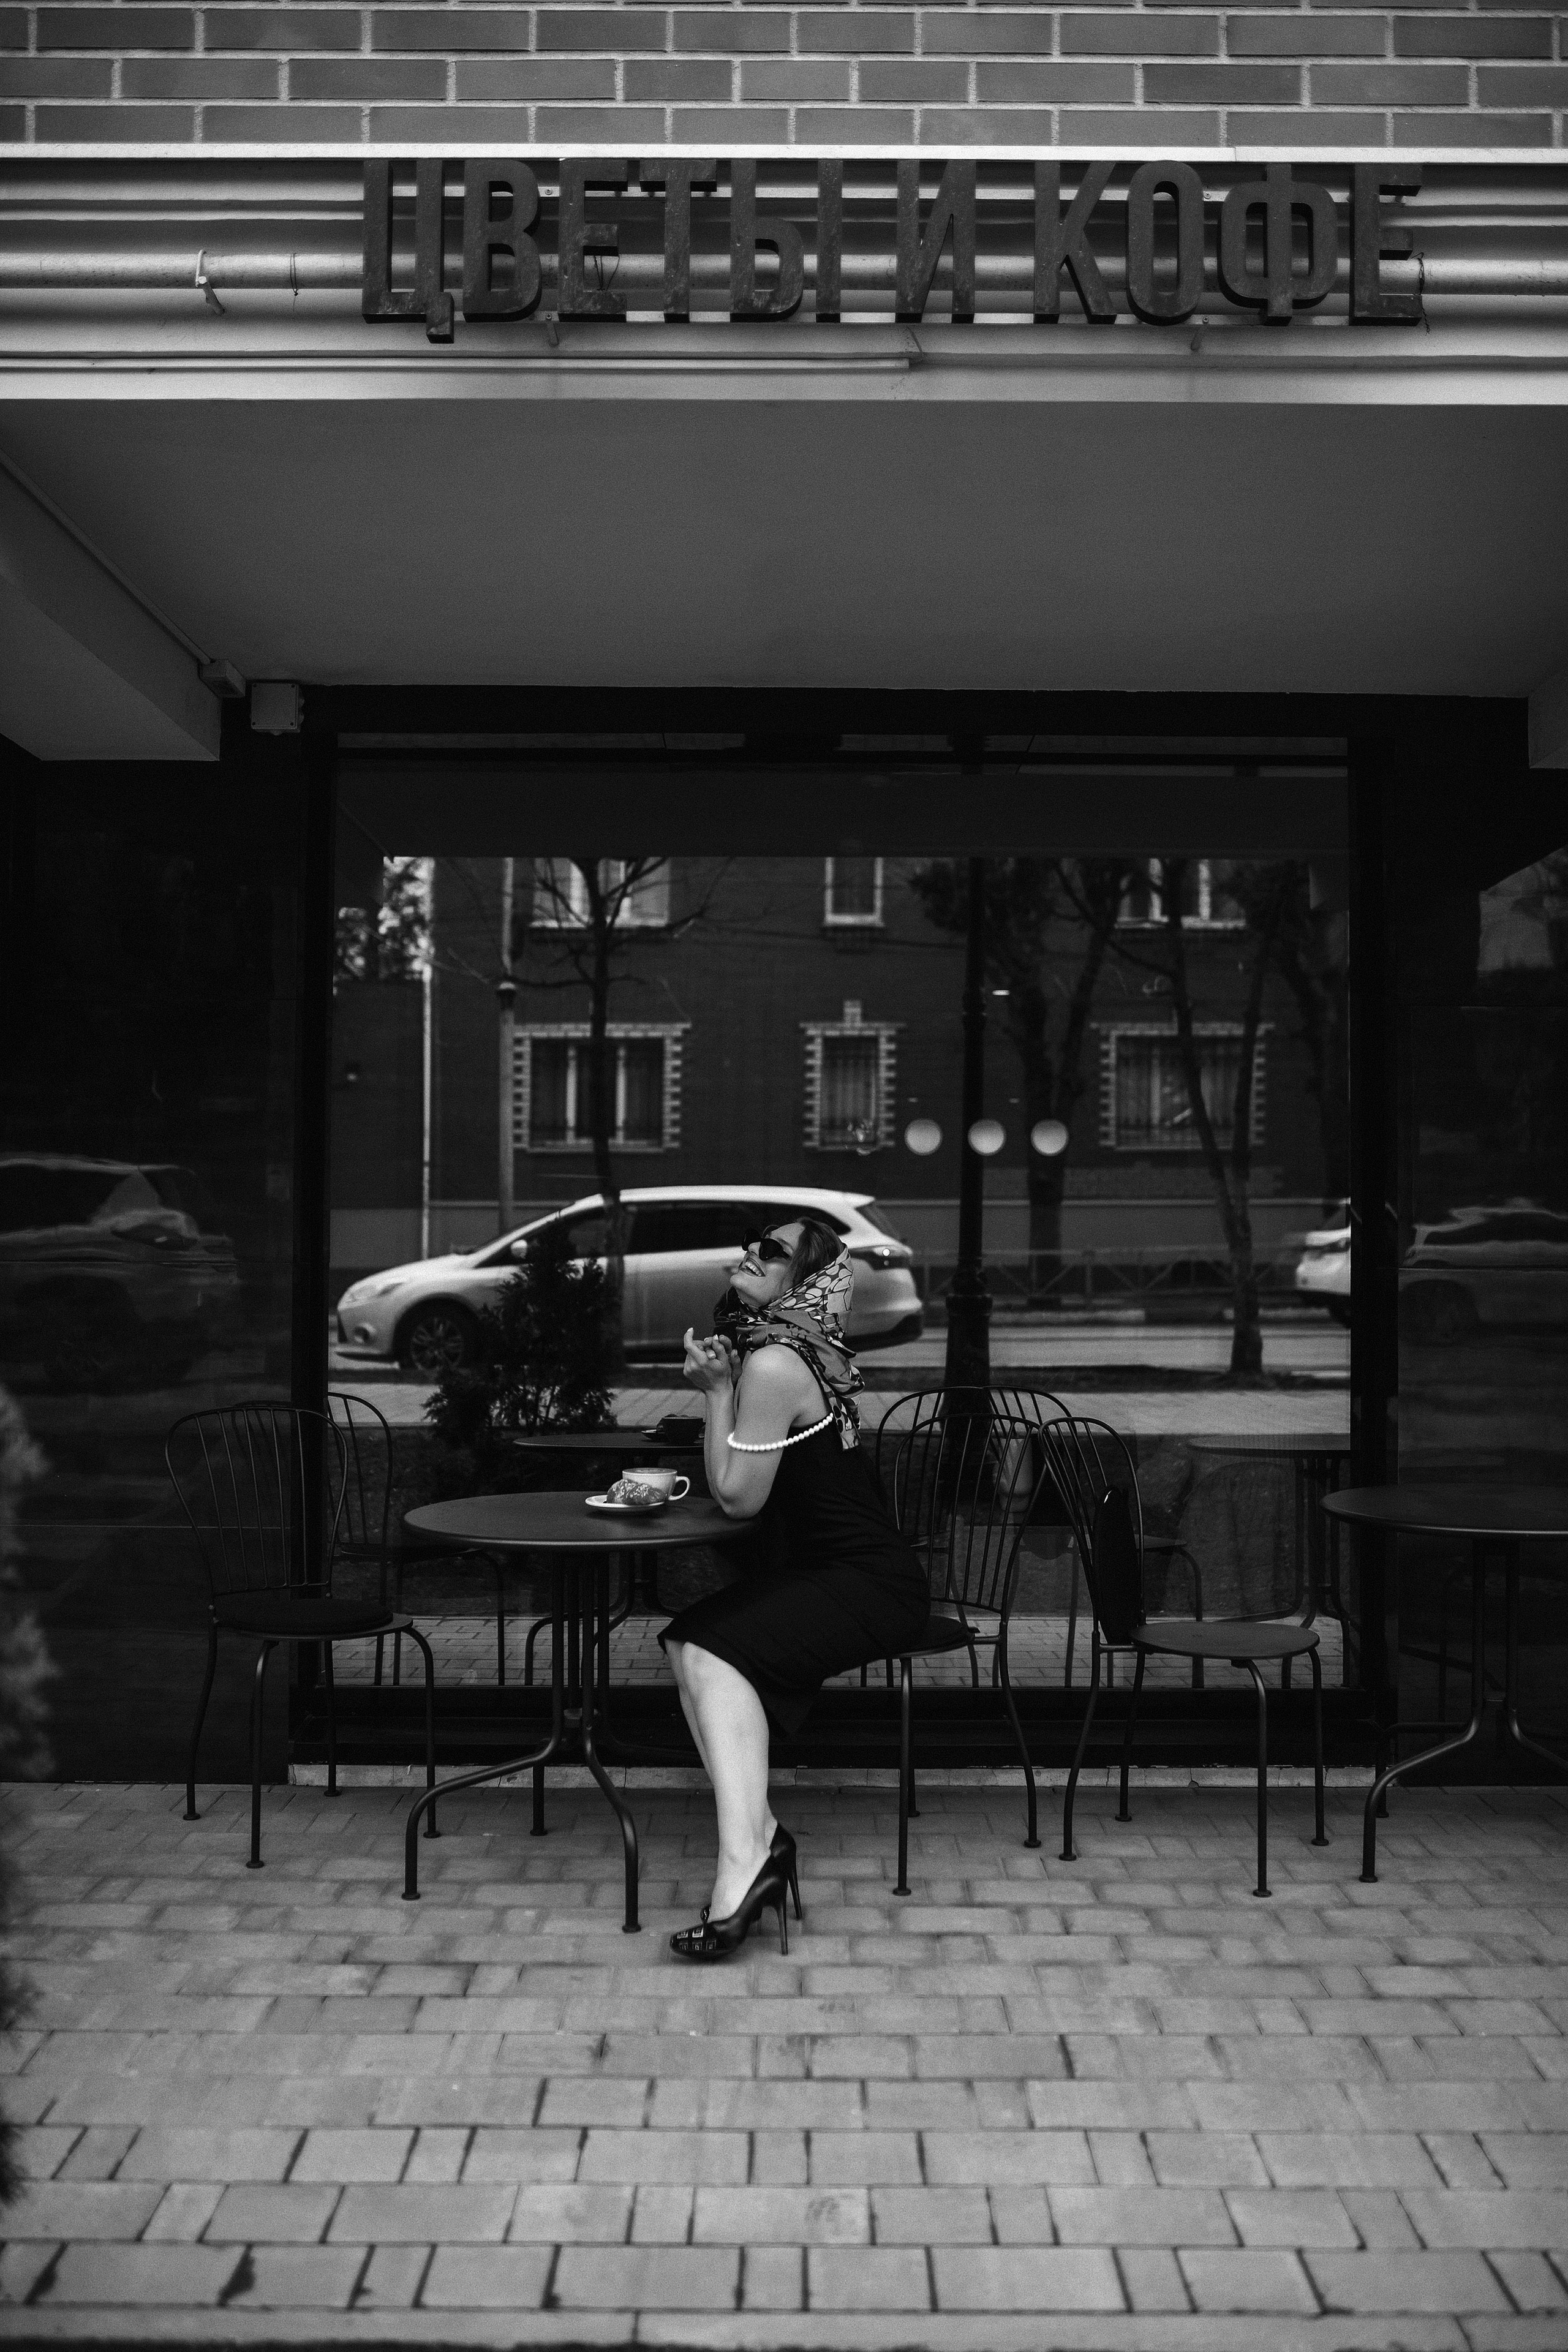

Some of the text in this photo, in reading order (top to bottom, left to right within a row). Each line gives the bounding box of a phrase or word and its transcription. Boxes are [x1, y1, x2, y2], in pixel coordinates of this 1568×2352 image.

[362, 159, 1423, 343] ЦВЕТЫ И КОФЕ
